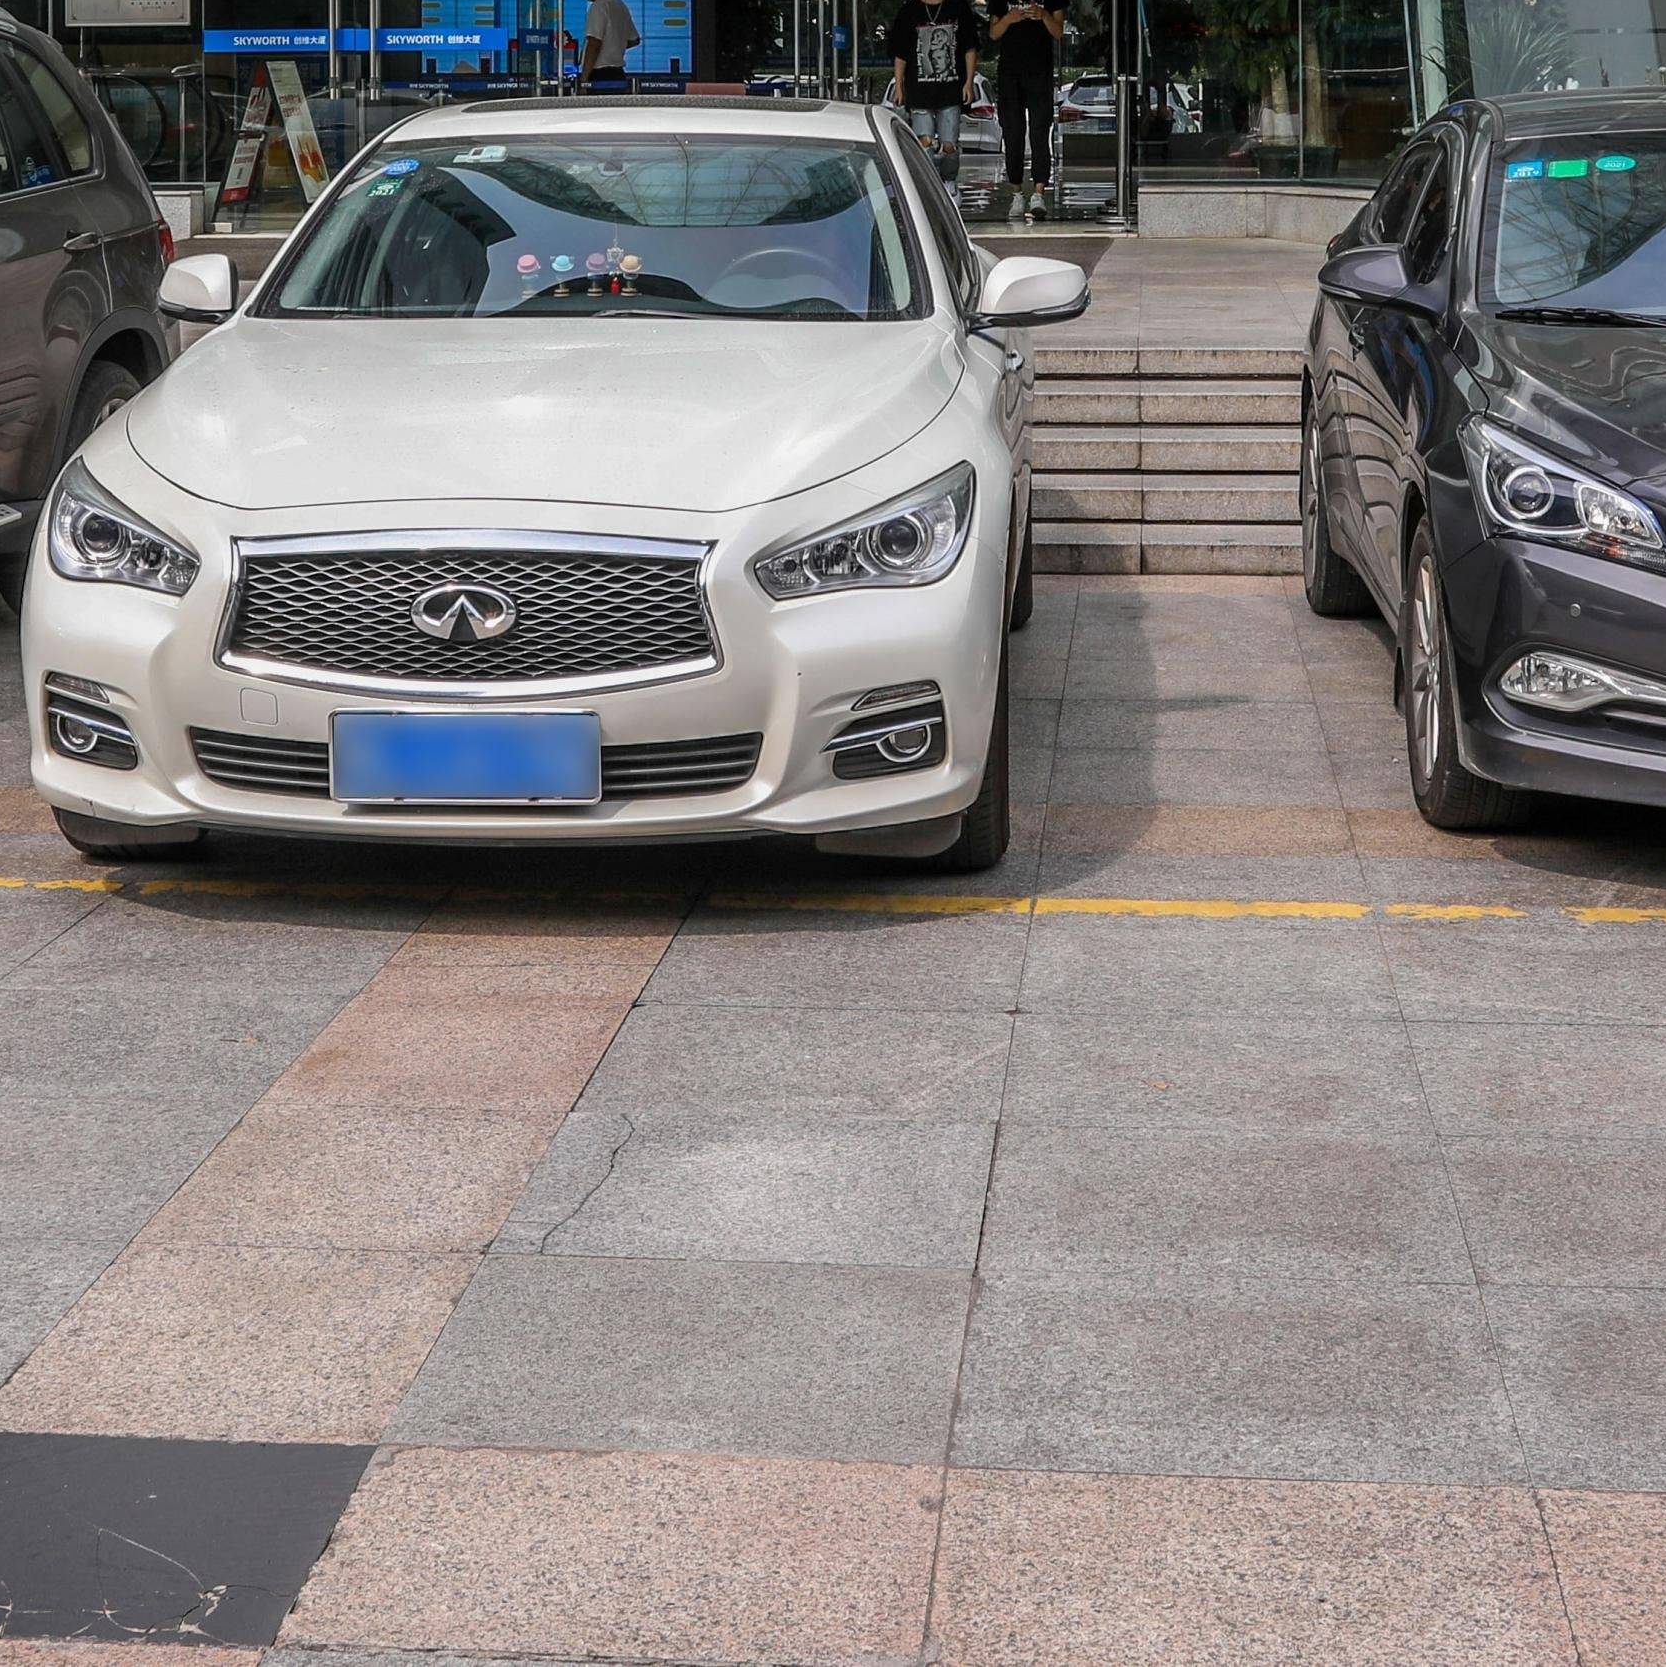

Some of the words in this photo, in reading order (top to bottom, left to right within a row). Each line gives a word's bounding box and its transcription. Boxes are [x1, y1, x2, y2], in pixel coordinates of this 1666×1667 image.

[233, 36, 290, 46] SKYWORTH
[293, 35, 327, 45] 创维大厦
[386, 35, 444, 45] SKYWORTH
[447, 34, 481, 45] 创维大厦
